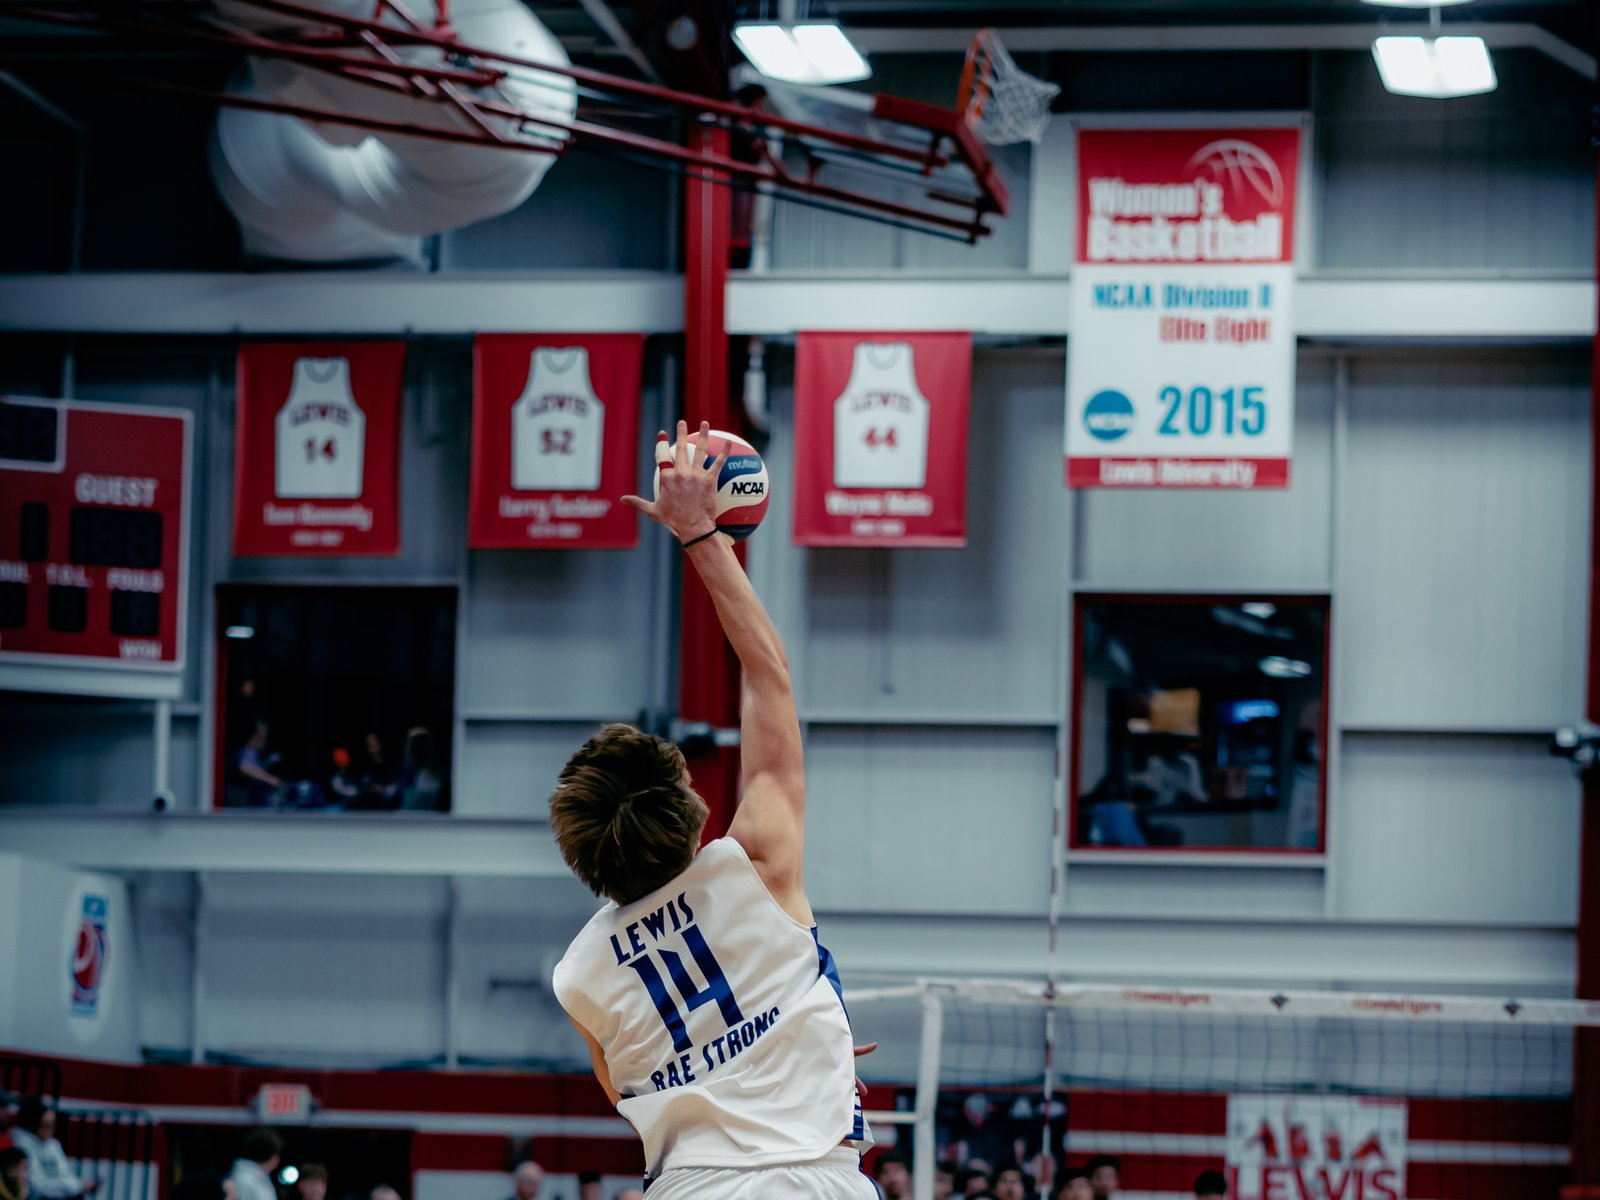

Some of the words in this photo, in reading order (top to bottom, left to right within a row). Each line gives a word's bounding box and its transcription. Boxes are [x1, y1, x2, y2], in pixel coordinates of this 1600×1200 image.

[1089, 177, 1223, 217] Women's
[1088, 213, 1282, 260] Basketball
[1093, 284, 1152, 309] NCAA
[1163, 284, 1249, 309] Division
[1157, 386, 1267, 437] 2015
[304, 437, 337, 464] 14
[863, 425, 900, 451] 44
[76, 473, 157, 506] GUEST
[731, 482, 764, 495] NCAA
[610, 891, 694, 966] LEWIS
[627, 923, 745, 1054] 14
[650, 1054, 696, 1092] RAE
